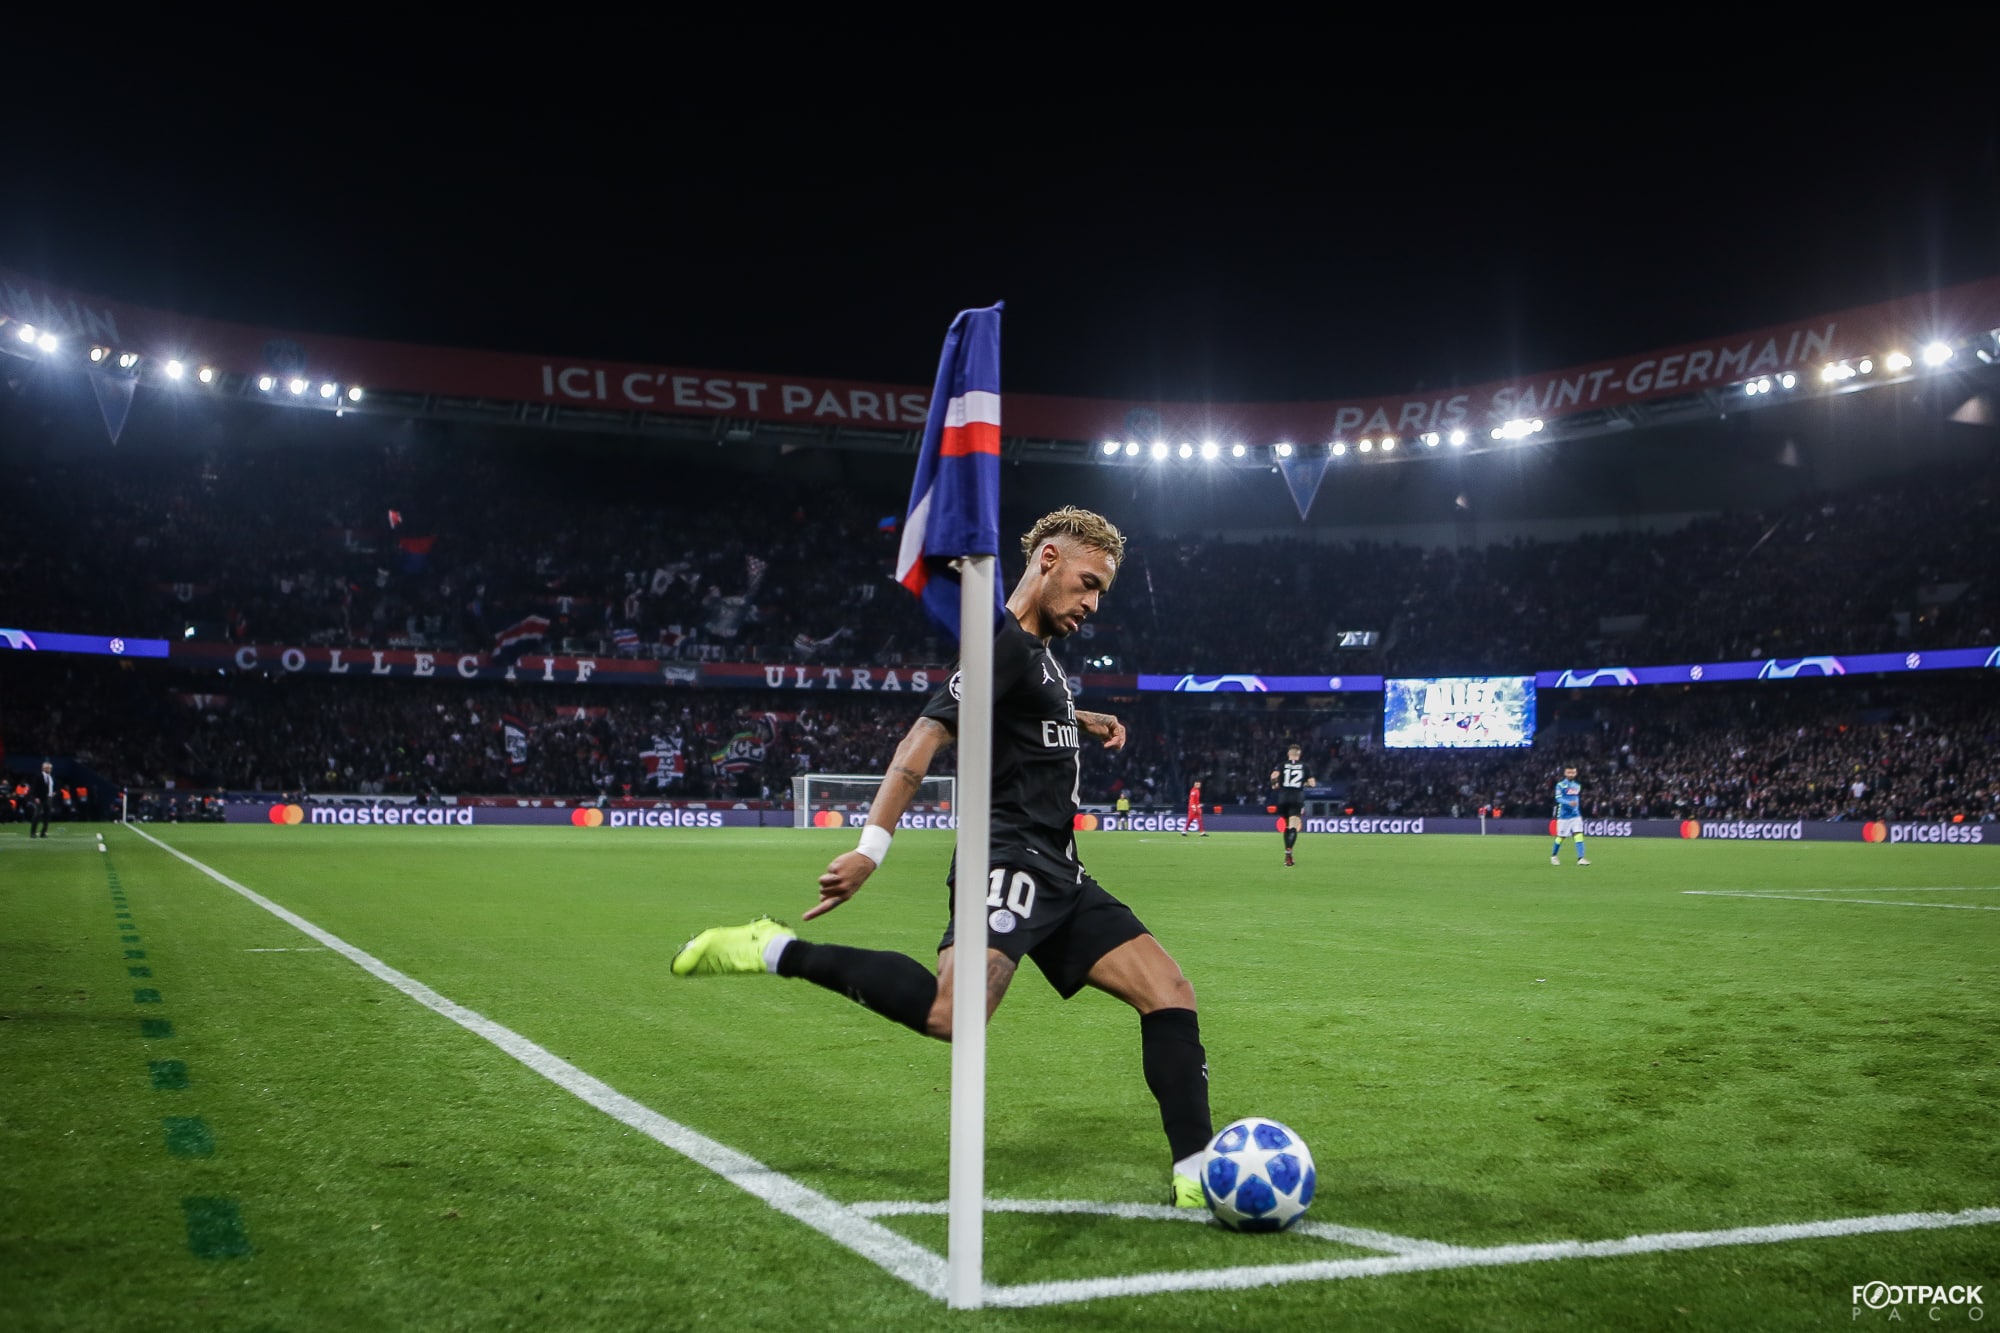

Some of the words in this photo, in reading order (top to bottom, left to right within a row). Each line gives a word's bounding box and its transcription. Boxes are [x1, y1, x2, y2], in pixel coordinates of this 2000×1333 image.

[1333, 397, 1468, 436] PARIS
[1491, 325, 1836, 416] SAINT-GERMAIN
[542, 365, 607, 400] ICI
[622, 374, 767, 412] C'EST
[781, 384, 929, 423] PARIS
[764, 665, 930, 692] ULTRAS
[1282, 769, 1304, 789] 12
[311, 804, 473, 825] mastercard
[610, 808, 722, 827] priceless
[1306, 816, 1424, 834] mastercard
[1702, 820, 1802, 840] mastercard
[1890, 821, 1983, 844] priceless
[985, 868, 1036, 919] 10
